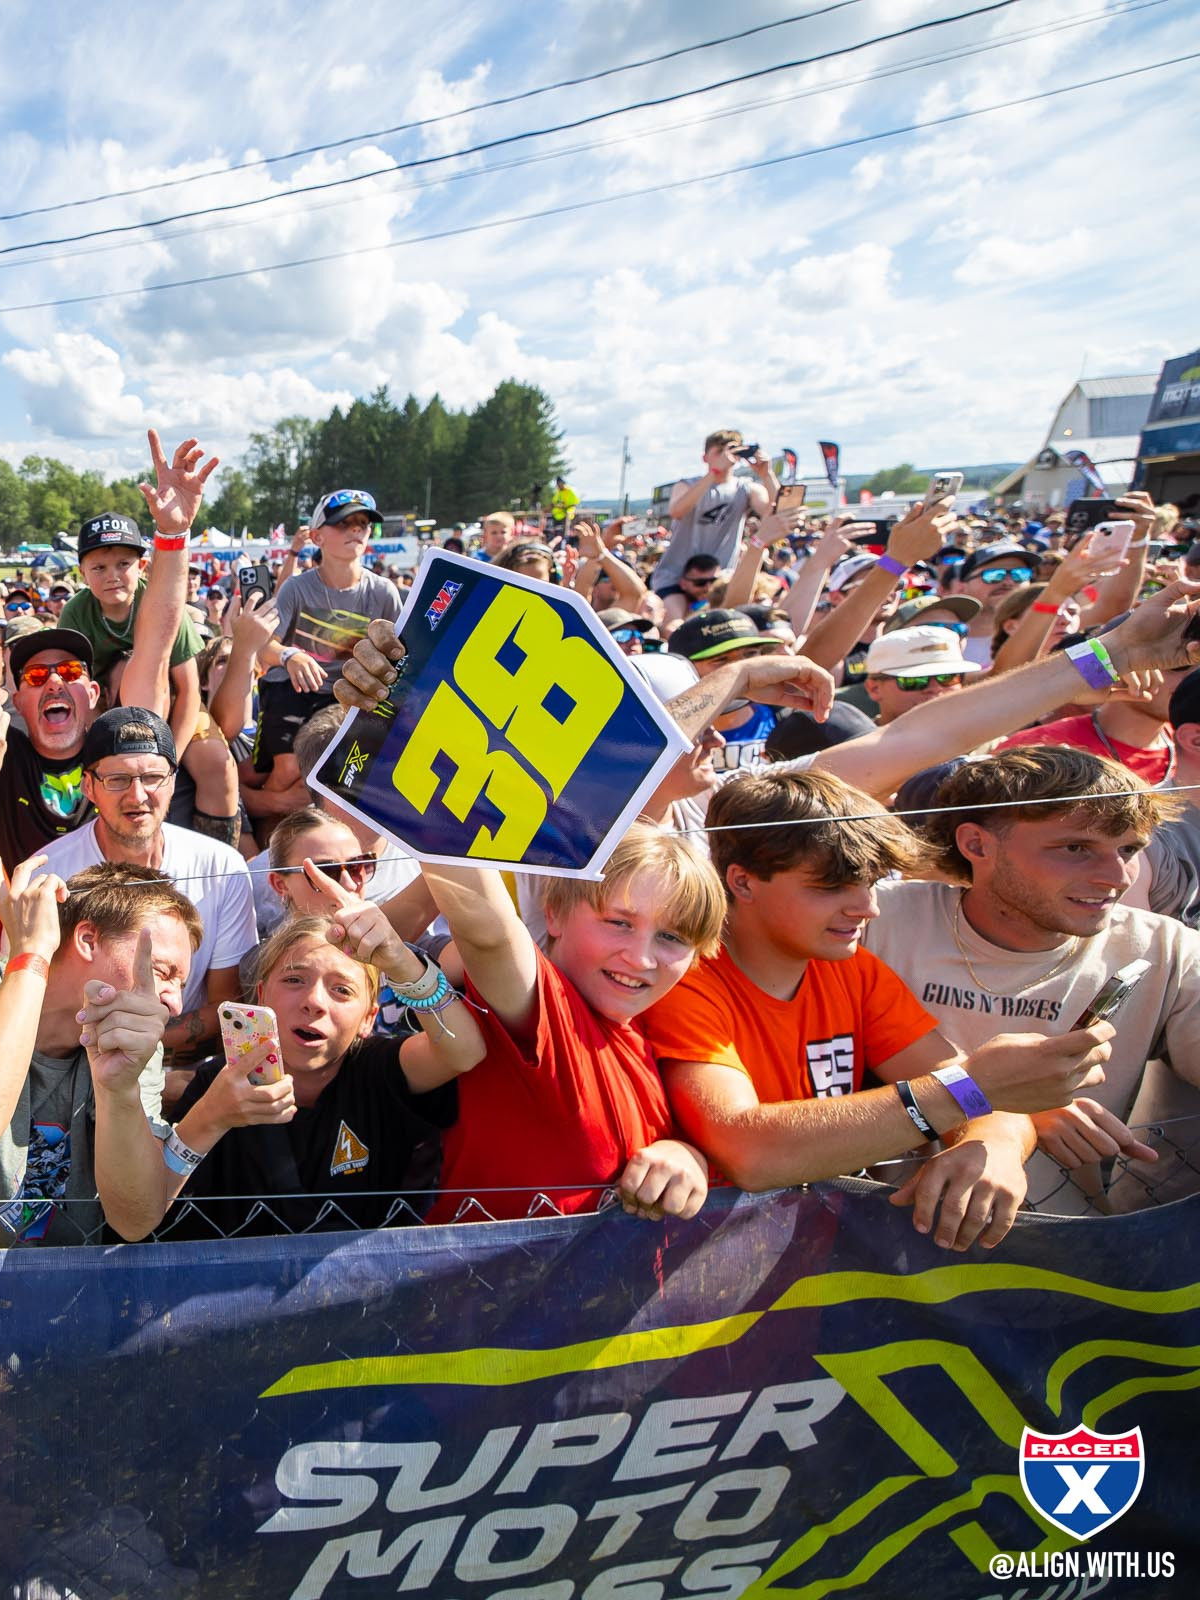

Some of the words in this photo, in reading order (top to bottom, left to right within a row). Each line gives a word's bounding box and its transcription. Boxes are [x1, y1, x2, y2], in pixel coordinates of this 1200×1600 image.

[102, 519, 128, 531] FOX
[424, 579, 464, 632] AMA
[391, 584, 625, 862] 38
[922, 981, 976, 1011] GUNS
[1001, 996, 1062, 1022] ROSES
[255, 1378, 849, 1534] SUPER
[288, 1464, 792, 1600] MOTO
